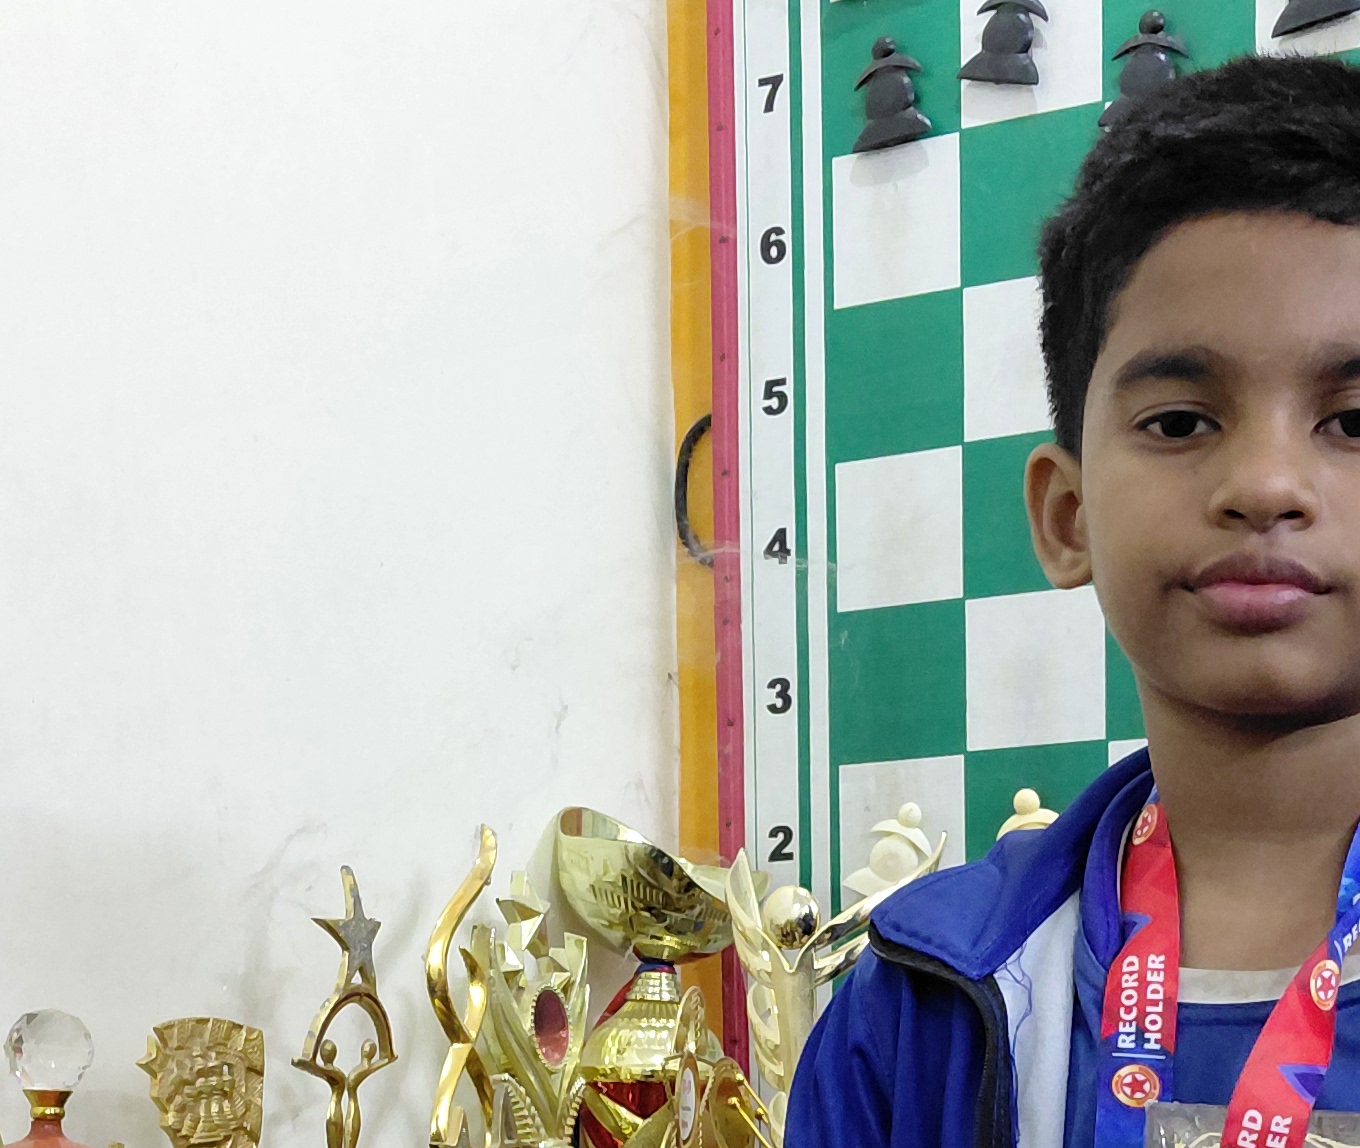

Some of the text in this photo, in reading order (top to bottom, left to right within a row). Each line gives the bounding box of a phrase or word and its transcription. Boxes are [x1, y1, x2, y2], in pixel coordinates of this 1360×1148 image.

[757, 72, 784, 114] 7
[759, 226, 786, 265] 6
[762, 377, 789, 416] 5
[764, 527, 791, 565] 4
[766, 678, 792, 715] 3
[767, 826, 794, 862] 2
[1117, 955, 1140, 1050] RECORD
[1142, 953, 1166, 1050] HOLDER
